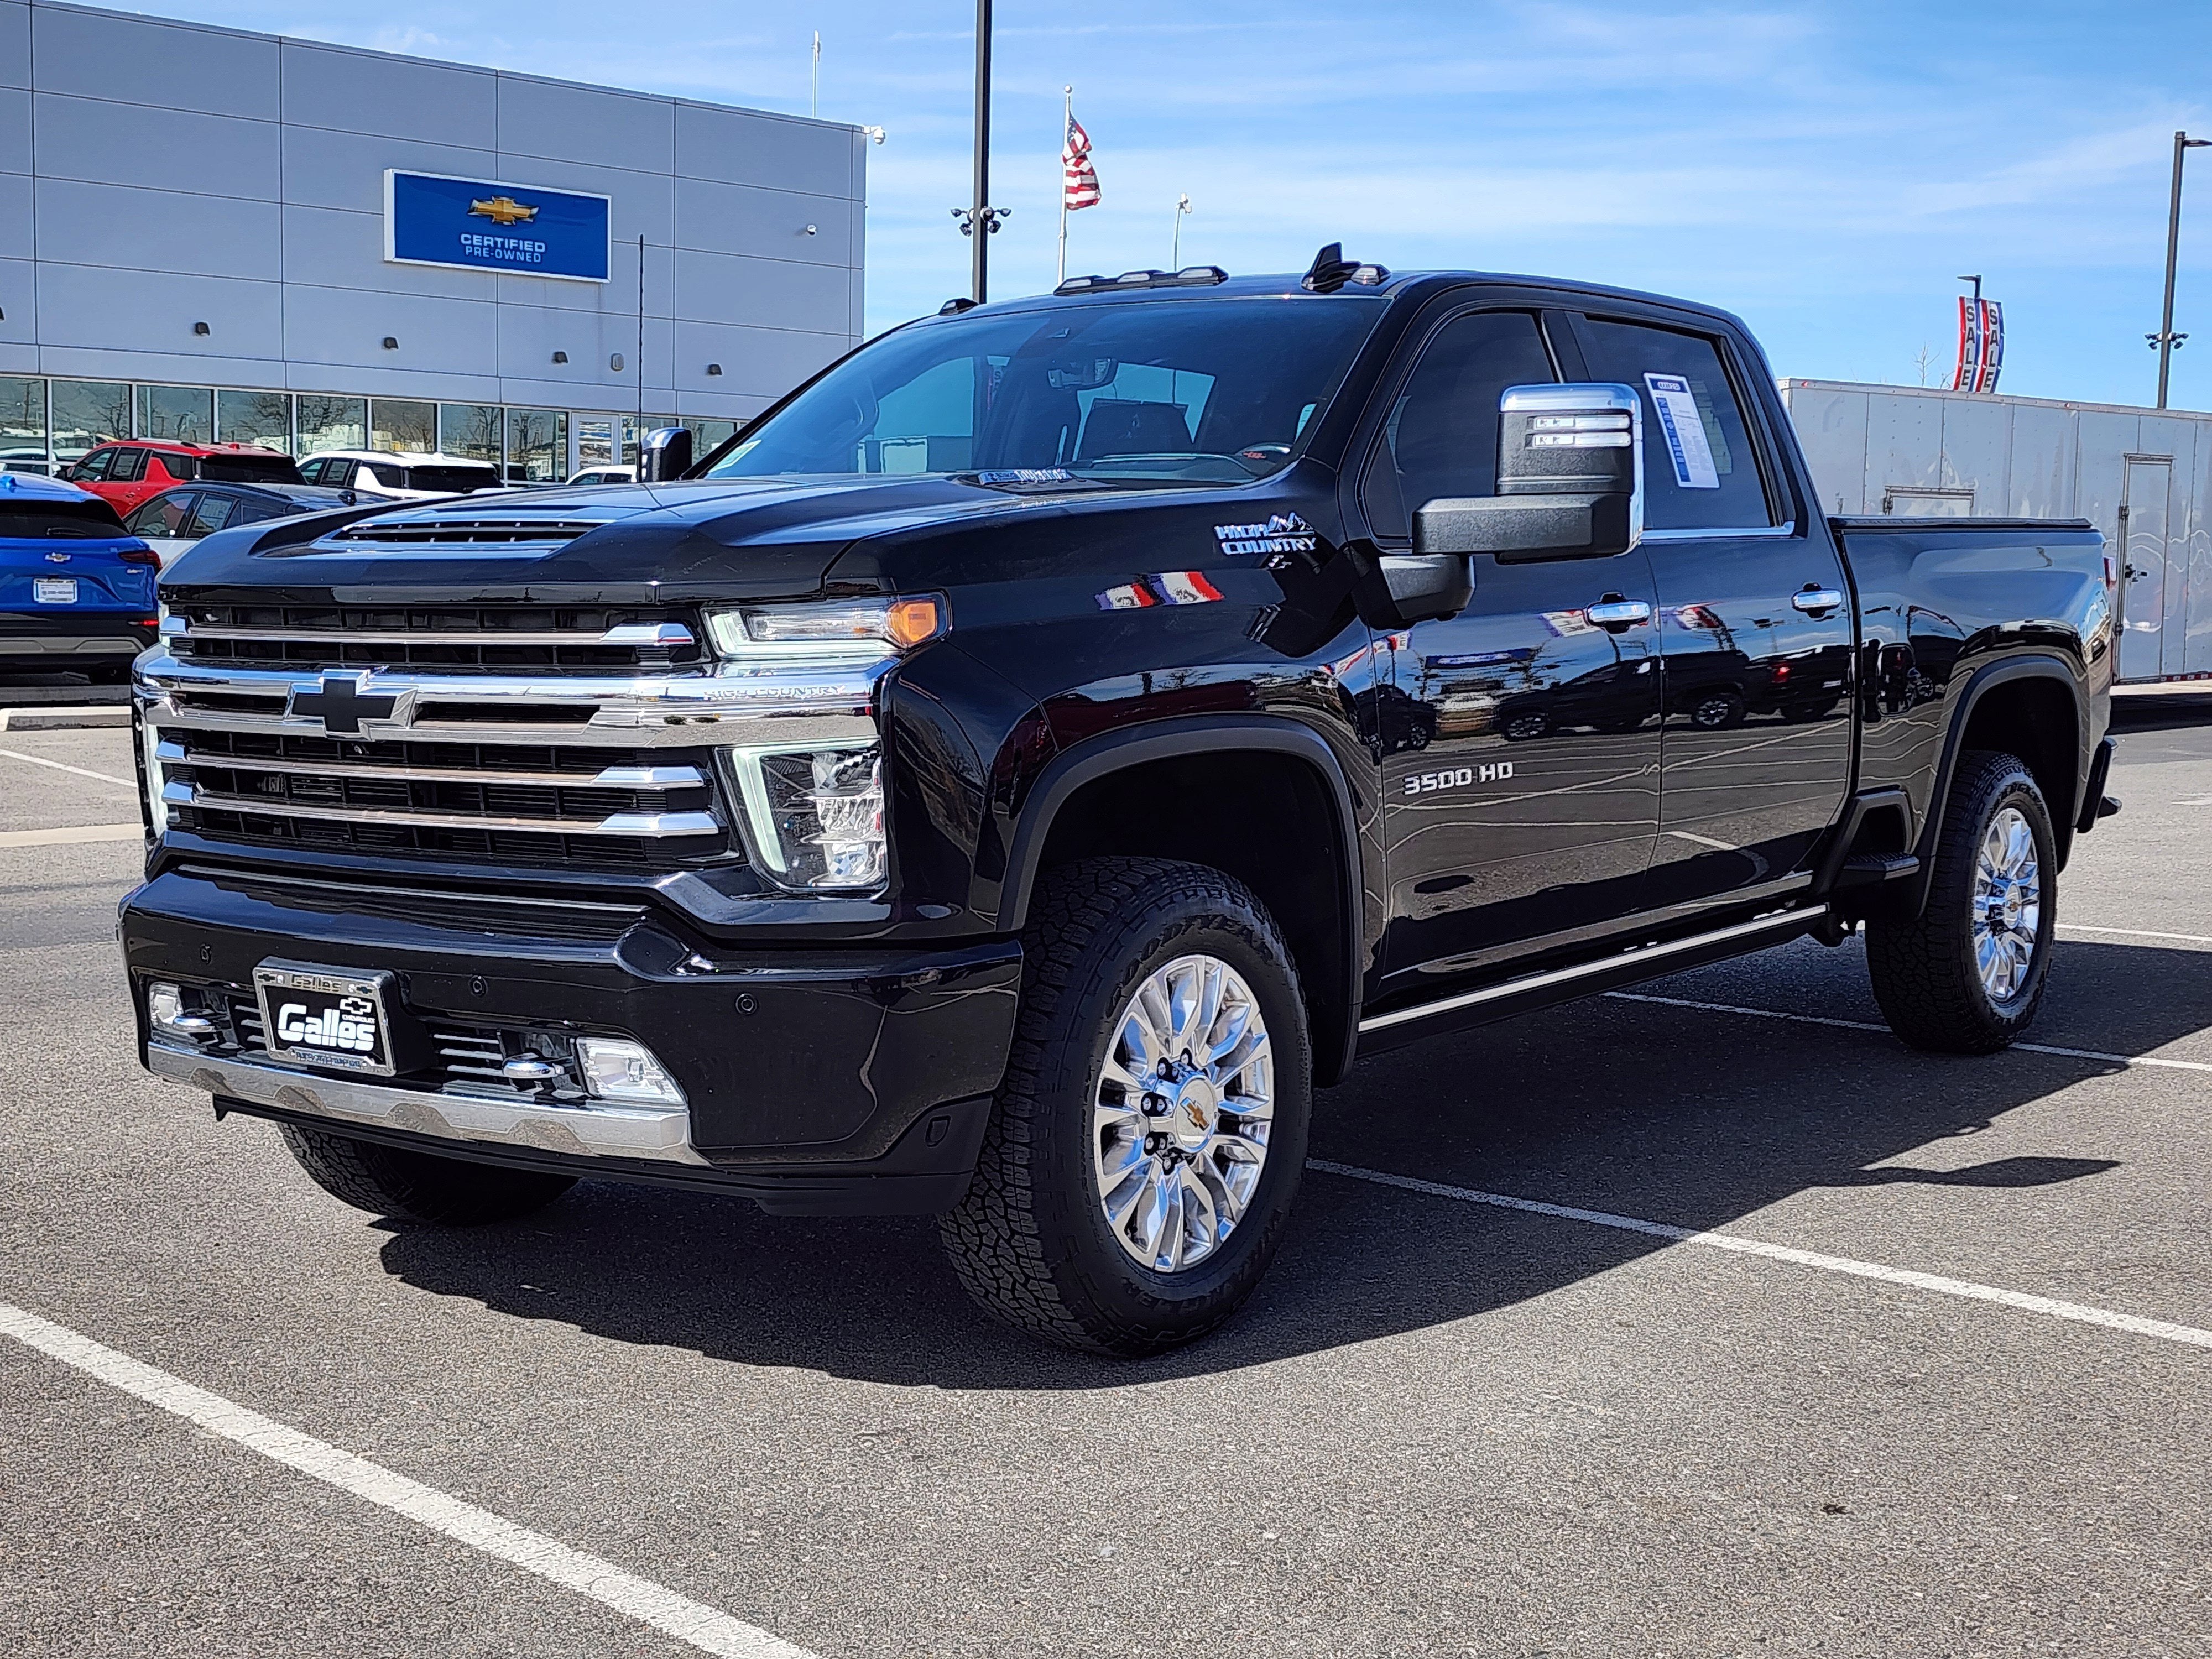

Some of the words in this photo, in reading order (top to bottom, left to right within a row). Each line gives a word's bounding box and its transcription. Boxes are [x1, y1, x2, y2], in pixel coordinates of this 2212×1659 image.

[460, 234, 546, 253] CERTIFIED
[466, 246, 541, 263] PRE-OWNED
[1961, 305, 1975, 386] SALE
[1984, 308, 1999, 388] SALE
[1214, 524, 1269, 540] HIGH
[1222, 537, 1316, 555] COUNTRY
[755, 685, 846, 698] COUNTRY
[1404, 768, 1472, 795] 3500
[1479, 761, 1513, 783] HD
[1105, 914, 1274, 1018] GOODYEAR
[278, 1003, 375, 1051] Galles
